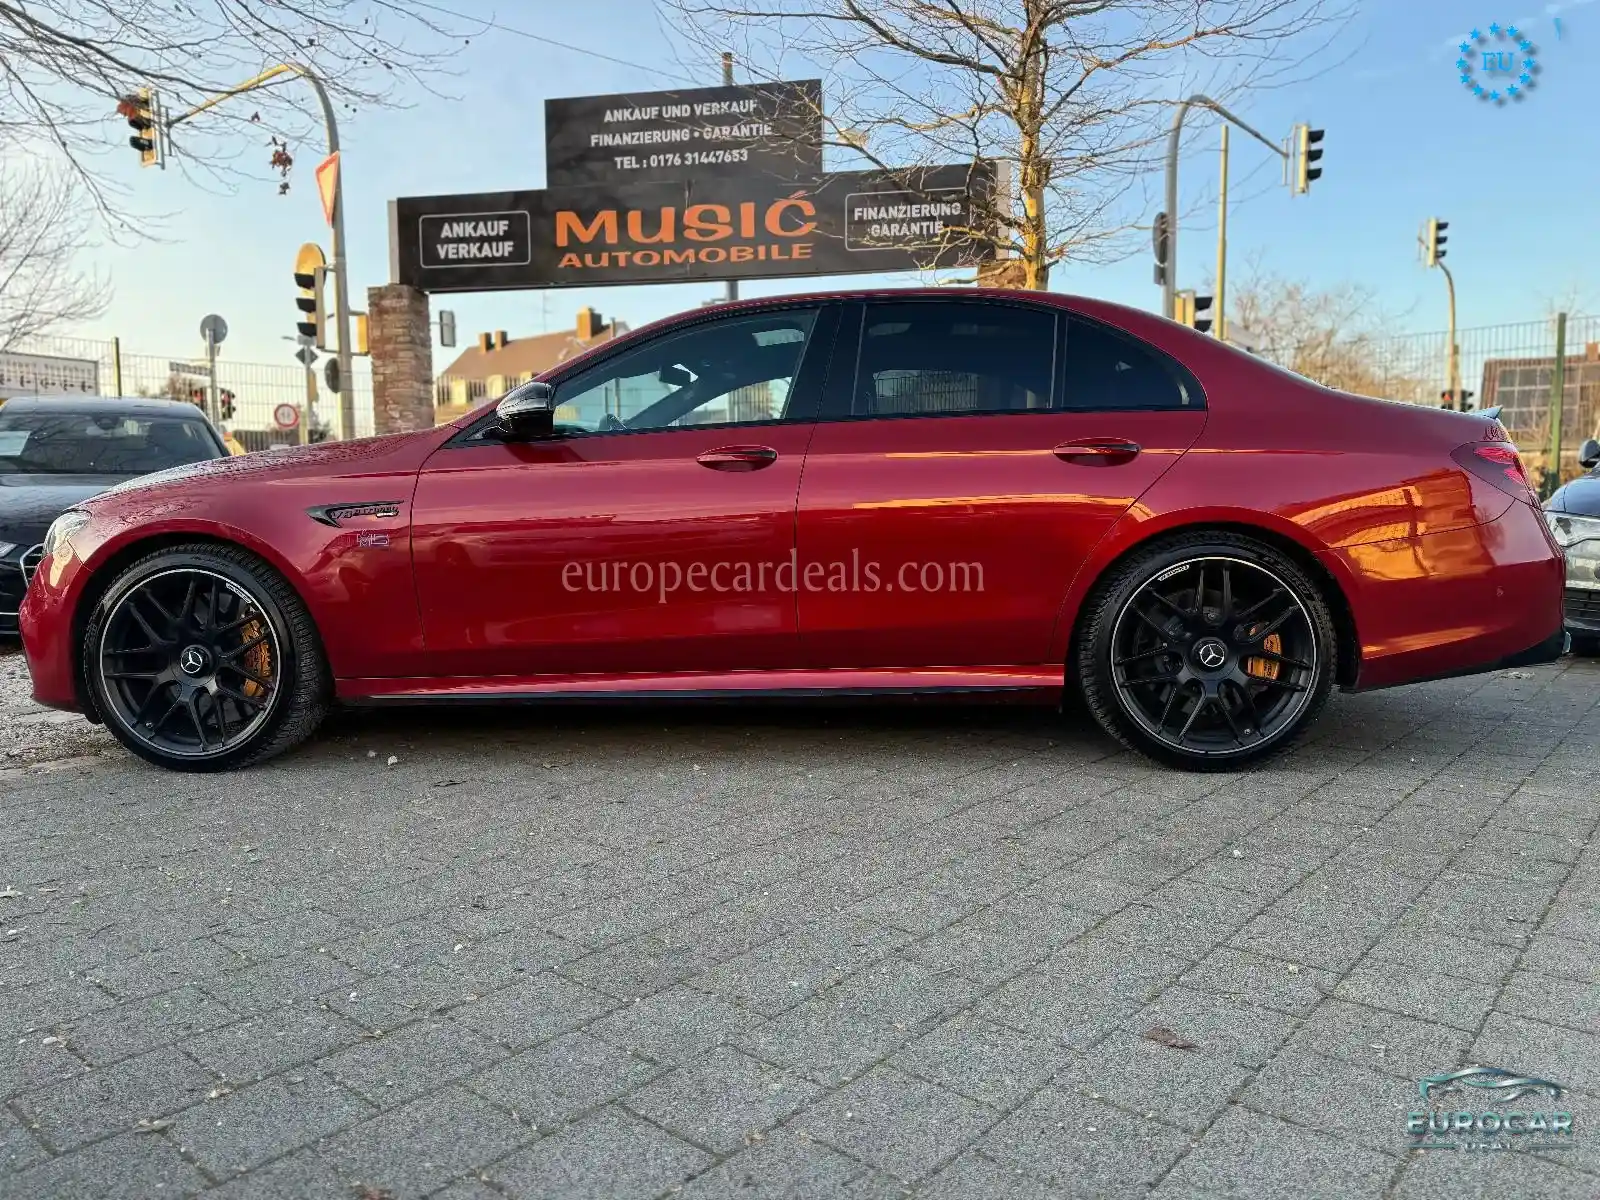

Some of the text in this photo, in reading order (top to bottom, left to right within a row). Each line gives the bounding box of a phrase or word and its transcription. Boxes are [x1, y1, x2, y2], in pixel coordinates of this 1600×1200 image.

[604, 99, 758, 122] ANKAUF UND VERKAUF
[590, 122, 773, 147] FINANZIERUNG GARANTIE
[650, 153, 682, 168] 0176
[684, 149, 748, 165] 31447653
[854, 202, 962, 221] FINANZIERUNG
[440, 220, 509, 239] ANKAUF
[871, 221, 944, 238] GARANTIE
[436, 241, 514, 260] VERKAUF
[557, 243, 814, 268] AUTOMOBILE
